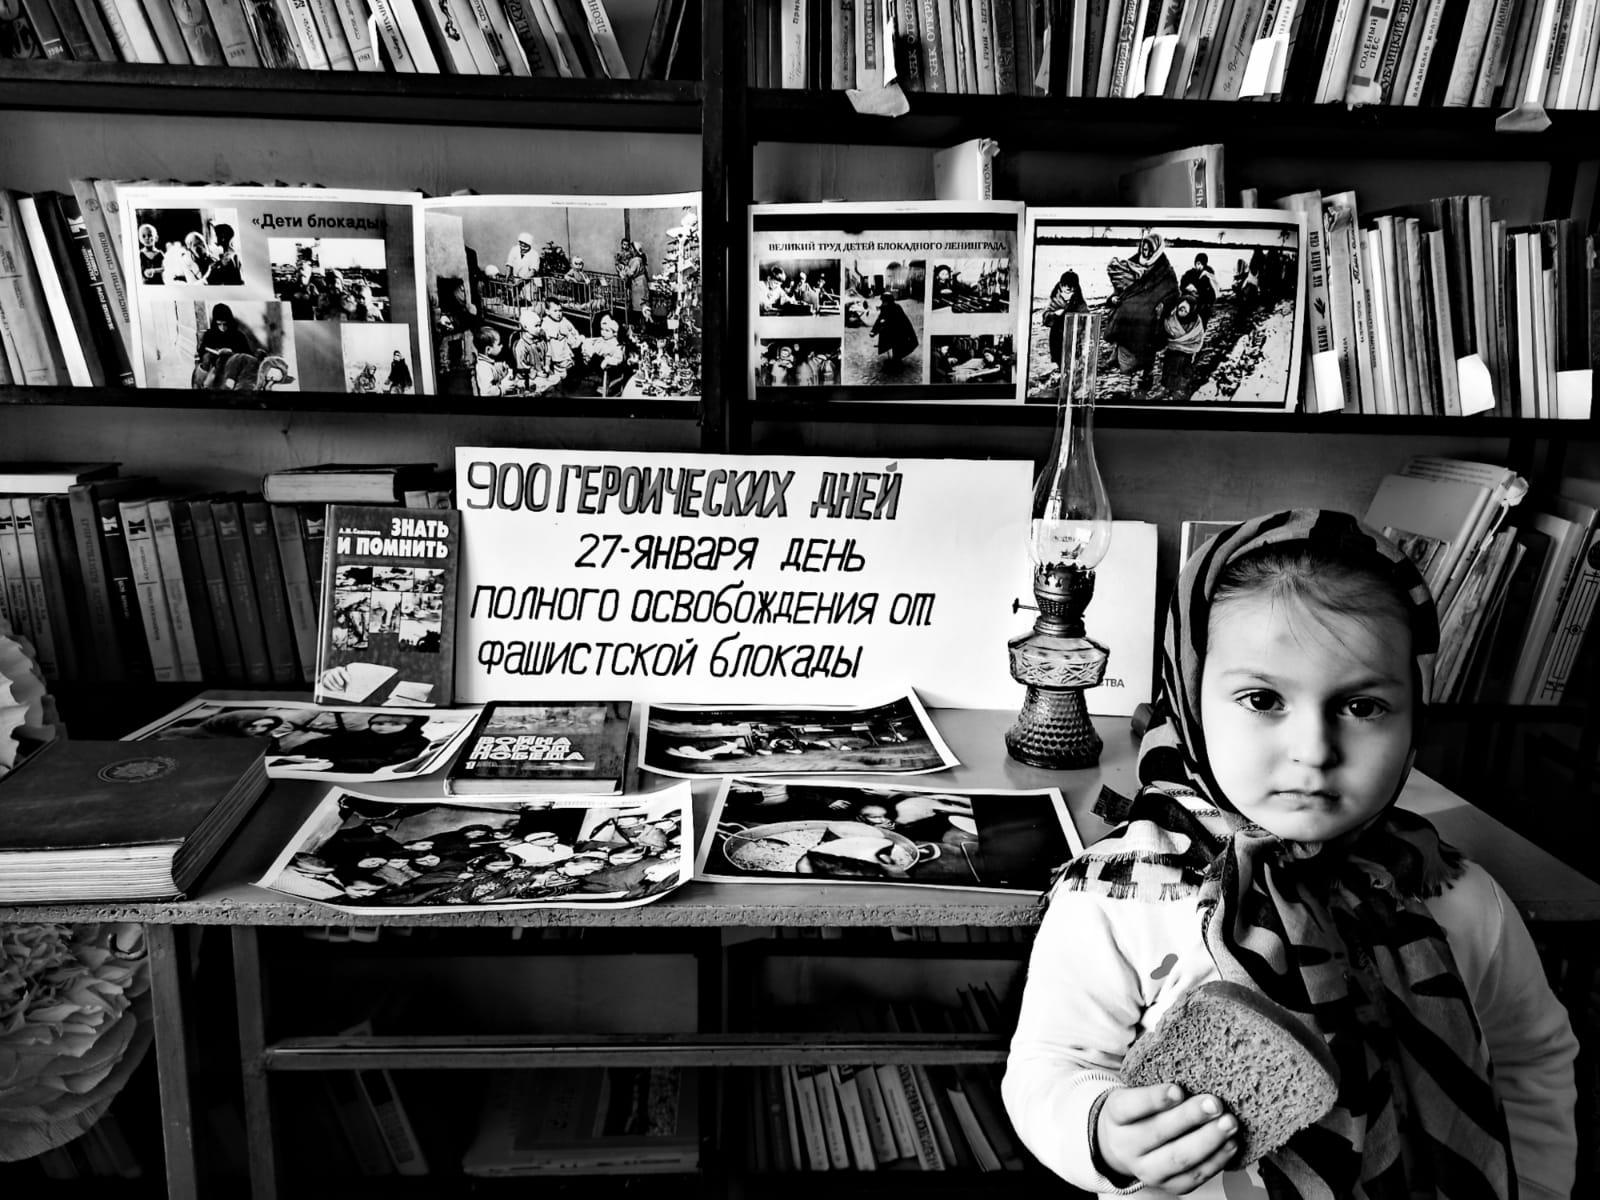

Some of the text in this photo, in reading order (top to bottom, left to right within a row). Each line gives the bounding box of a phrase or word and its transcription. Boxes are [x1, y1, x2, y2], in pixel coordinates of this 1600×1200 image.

[251, 213, 302, 230] «Дети
[769, 241, 815, 251] ВЕЛИКИЙ
[818, 243, 842, 252] ТРУД
[842, 241, 875, 252] ДЕТЕЙ
[877, 242, 943, 252] БЛОКАДНОГО
[467, 461, 903, 520] 900 ГЕРОИЧЕСКИХ ДНЕЙ
[391, 517, 449, 538] ЗНАТЬ
[337, 537, 448, 558] И ПОМНИТЬ
[780, 538, 866, 572] ДЕНЬ
[470, 585, 620, 622] ПОЛНОГО
[468, 751, 585, 761] ПОБЕДА
